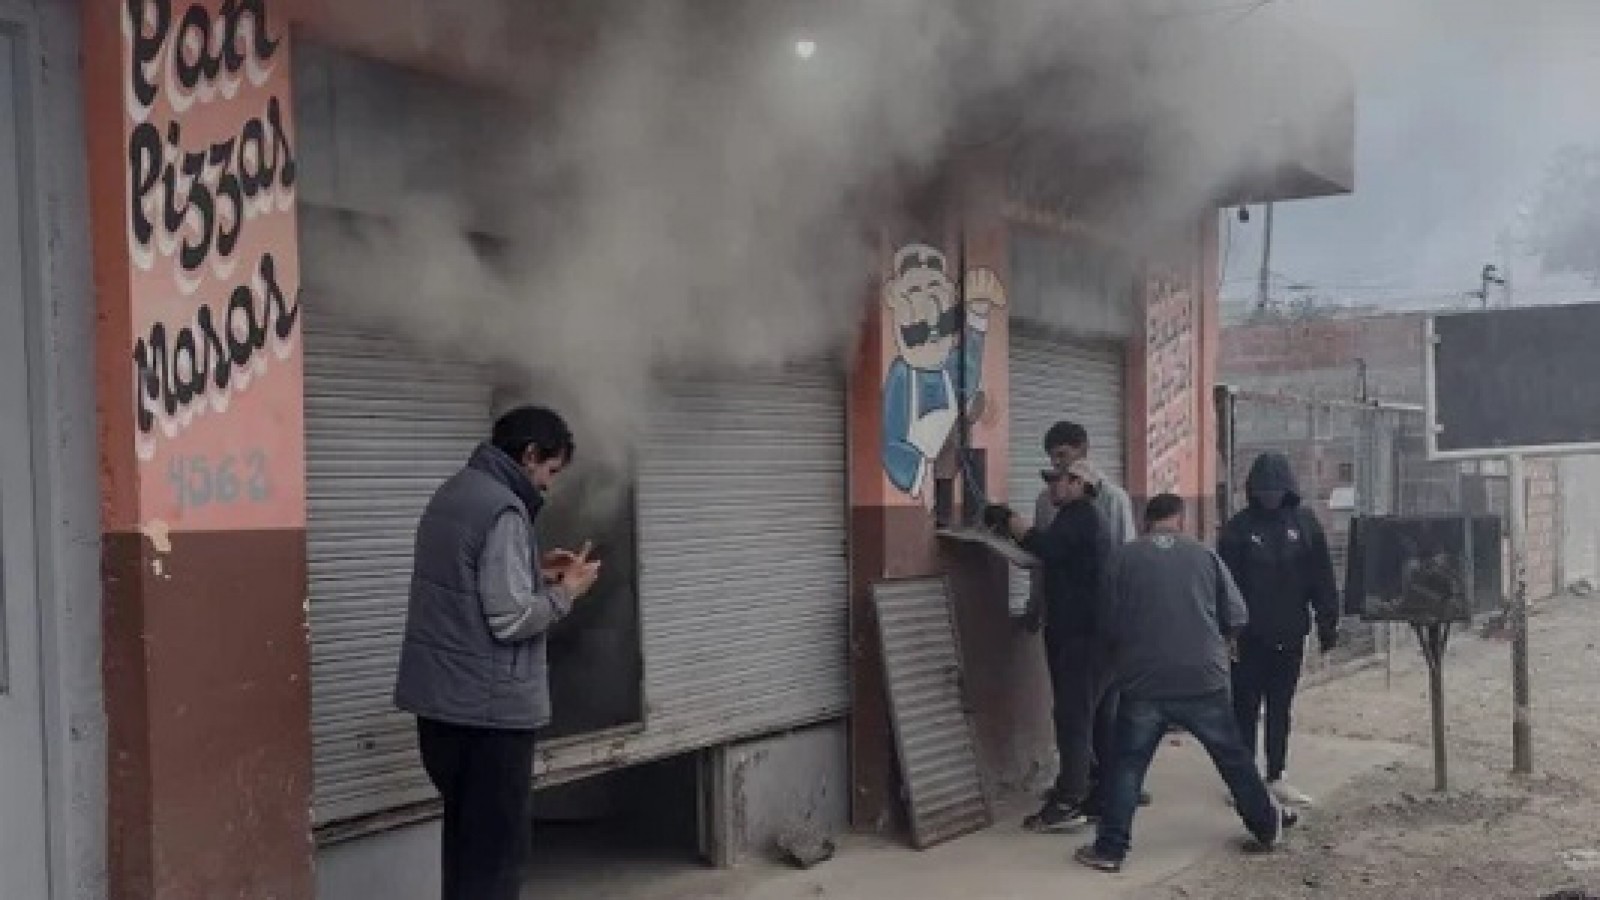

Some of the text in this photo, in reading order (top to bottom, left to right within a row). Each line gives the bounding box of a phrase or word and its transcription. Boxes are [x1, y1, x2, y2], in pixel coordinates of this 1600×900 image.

[126, 0, 279, 106] Pan
[129, 97, 295, 270] Pizzas
[135, 253, 301, 433] Masas
